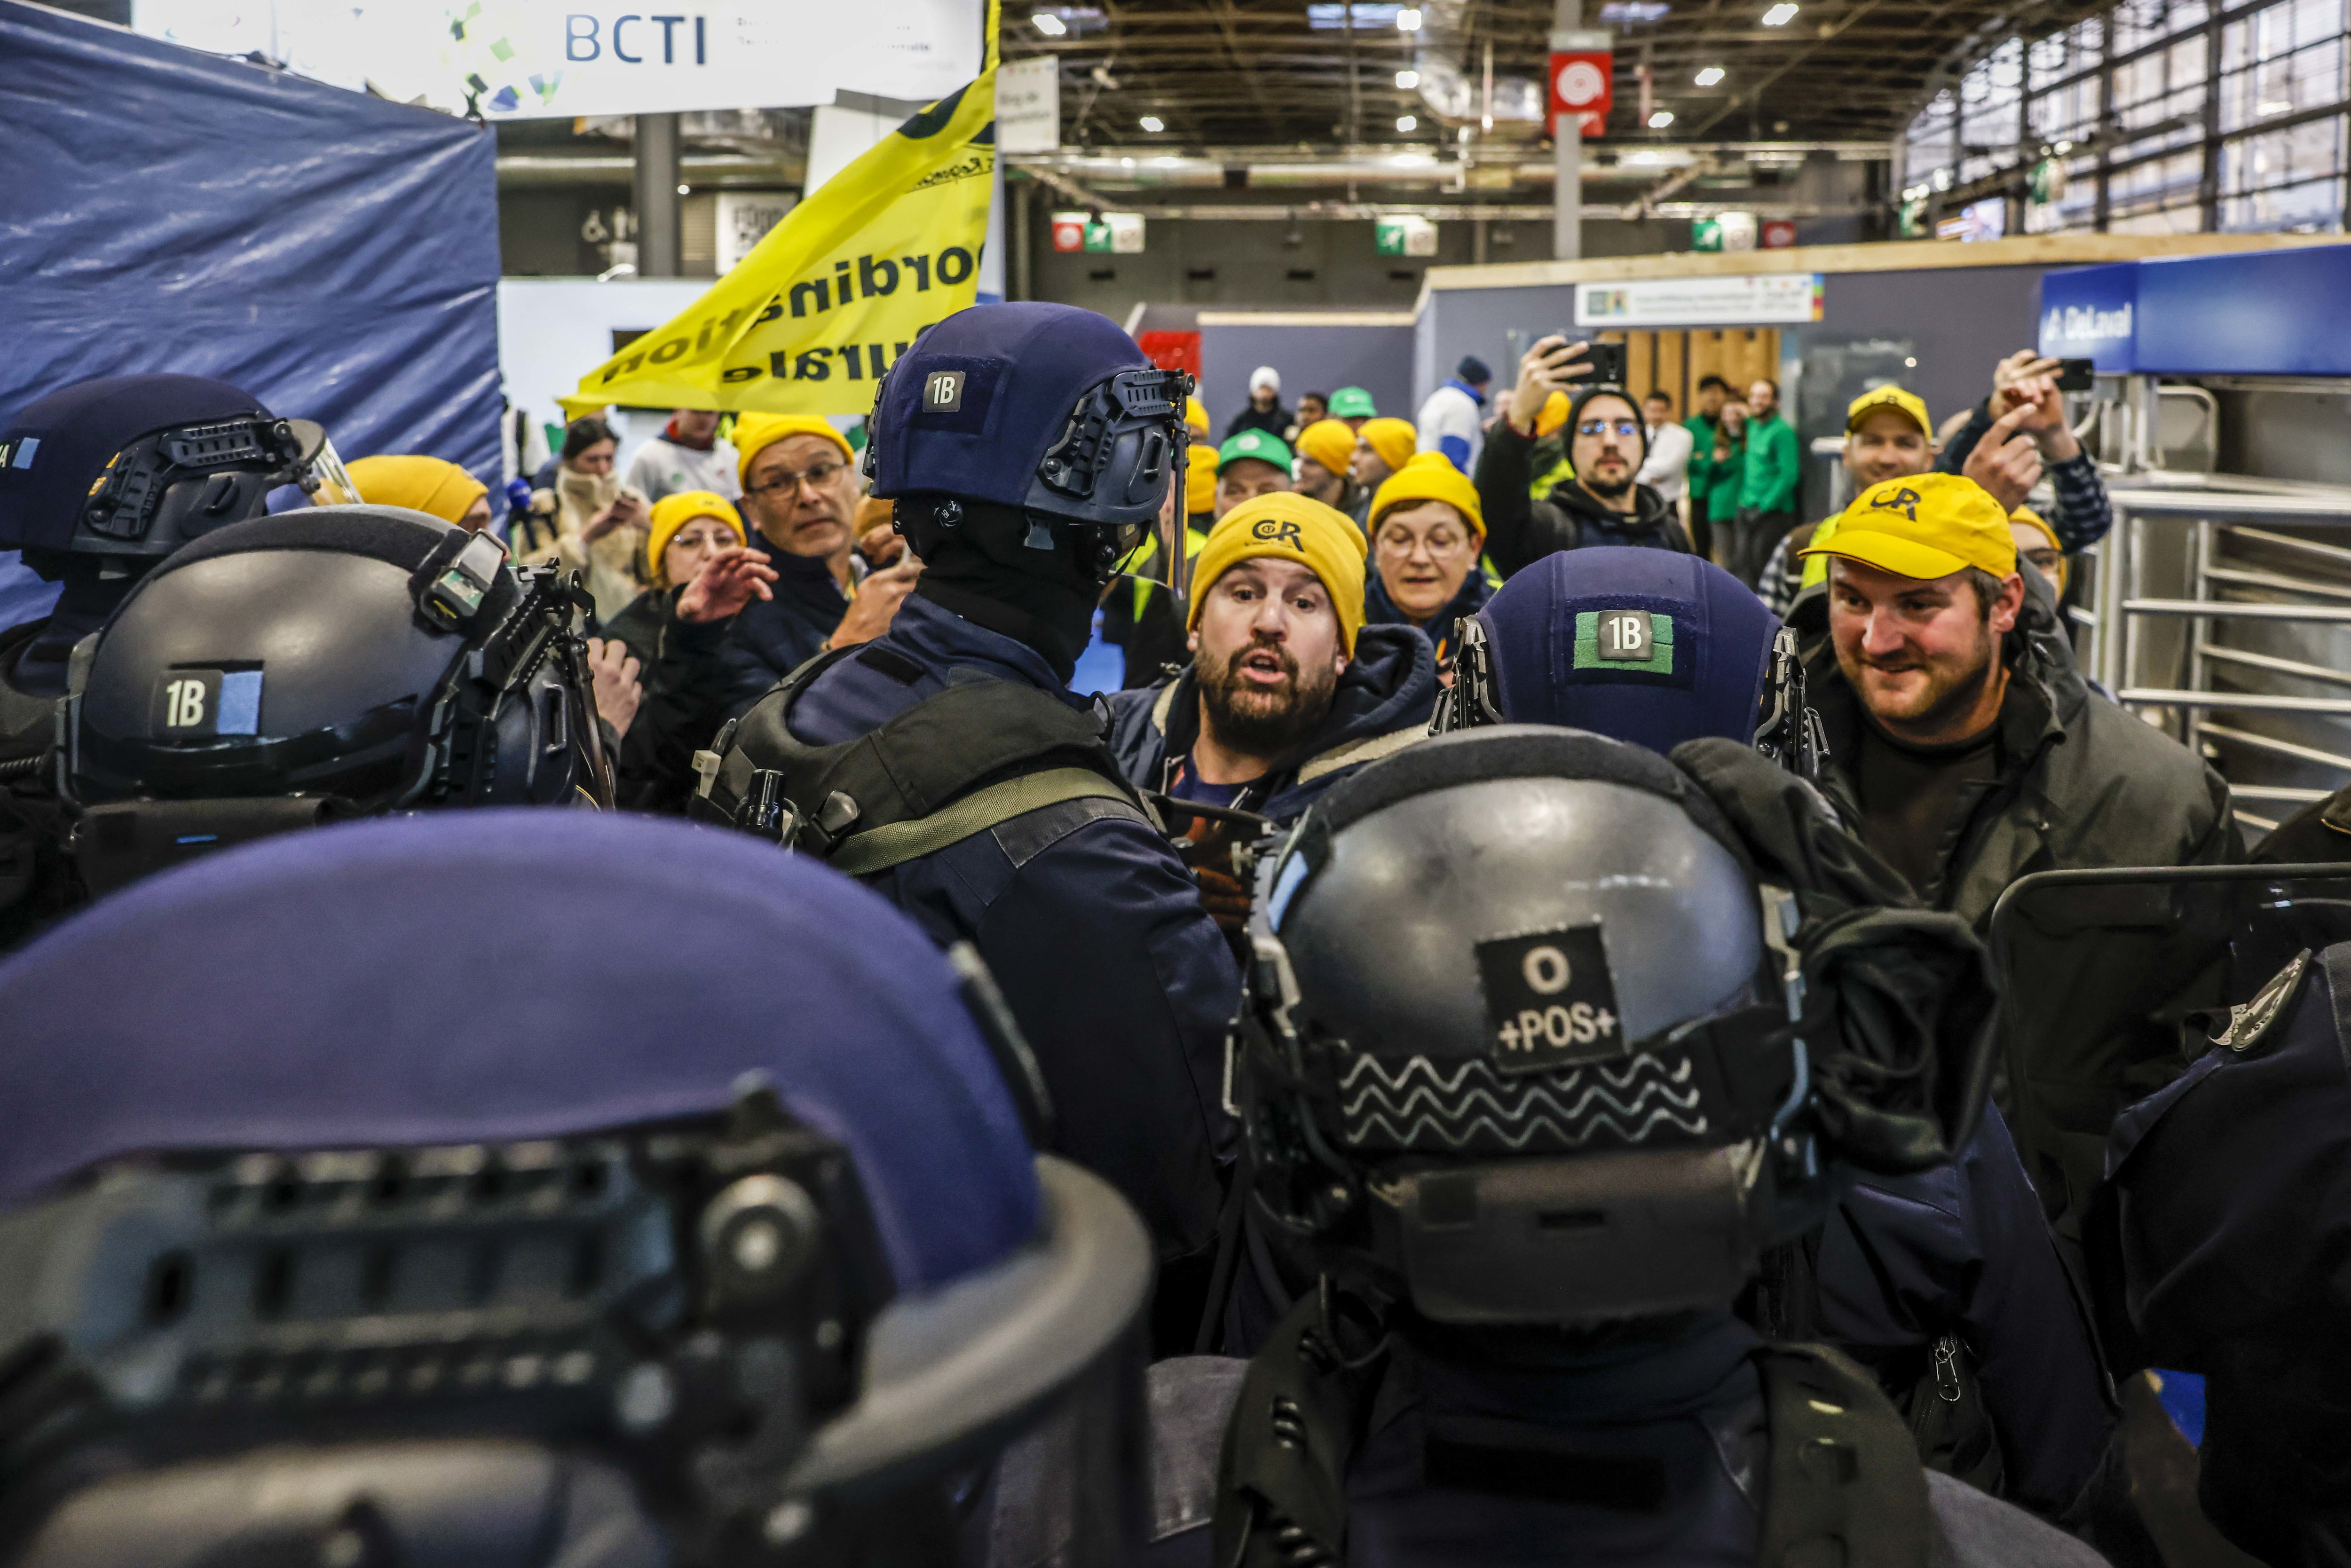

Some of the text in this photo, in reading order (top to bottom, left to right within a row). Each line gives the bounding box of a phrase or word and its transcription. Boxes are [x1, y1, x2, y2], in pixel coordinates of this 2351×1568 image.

[566, 14, 704, 64] BCTI
[2065, 302, 2132, 340] DeLaval
[933, 377, 955, 404] 1B
[1609, 617, 1642, 649] 1B
[166, 679, 206, 727] 1B
[1522, 945, 1571, 996] O
[1498, 1001, 1616, 1053] +POS+
